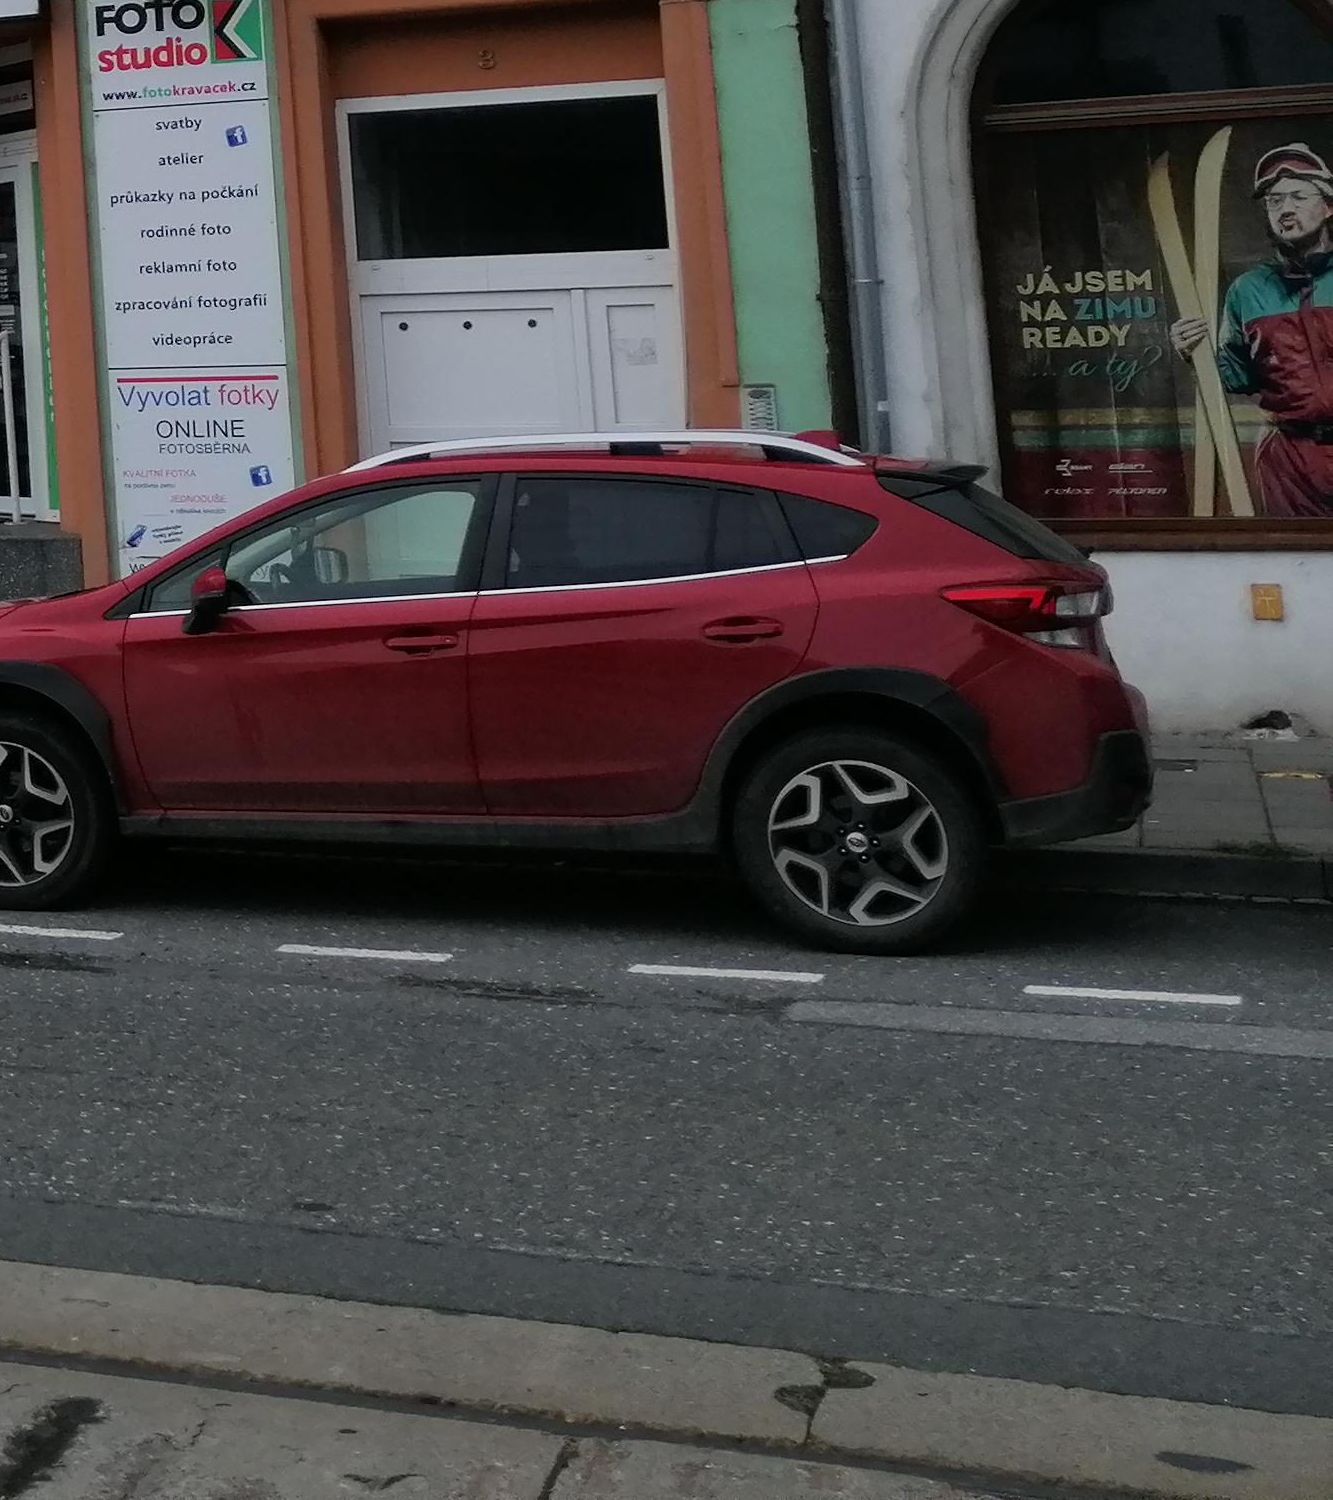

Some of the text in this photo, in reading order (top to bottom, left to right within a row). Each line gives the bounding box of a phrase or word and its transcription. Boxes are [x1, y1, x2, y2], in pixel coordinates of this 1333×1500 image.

[98, 36, 208, 72] studio
[102, 80, 256, 101] www.fotokravacek.cz
[155, 117, 202, 131] svatby
[158, 153, 204, 166] atelier
[110, 184, 259, 207] průkazky na počkání
[140, 223, 232, 238] rodinné foto
[139, 259, 237, 275] reklamní foto
[1016, 265, 1153, 295] JÁ JSEM
[115, 293, 267, 314] zpracování fotografií
[1019, 296, 1156, 322] NA ZIMU
[152, 332, 233, 348] videopráce
[1022, 323, 1132, 349] READY
[117, 384, 280, 412] Vyvolat fotky
[156, 419, 246, 438] ONLINE
[158, 441, 251, 455] FOTOSBĚRNA
[123, 468, 197, 479] KVALITNÍ FOTKA
